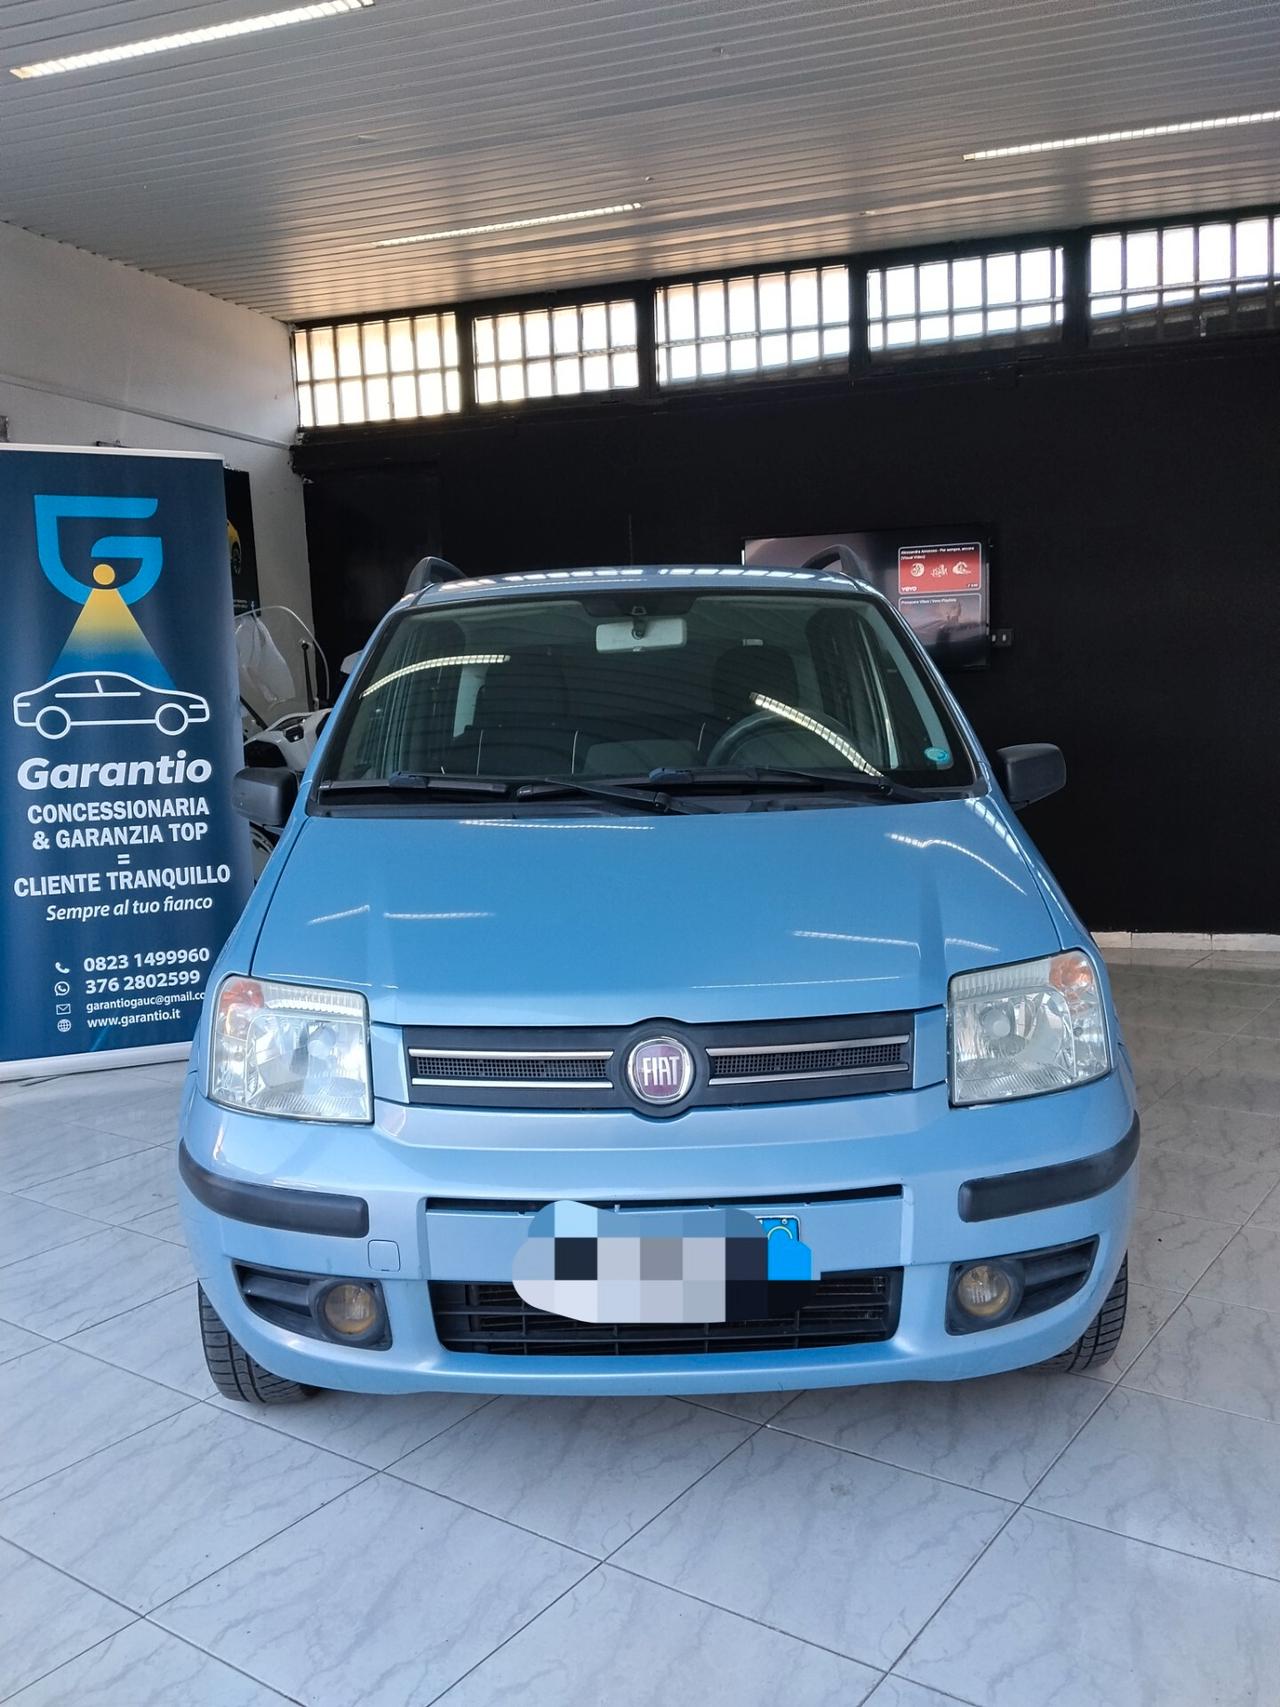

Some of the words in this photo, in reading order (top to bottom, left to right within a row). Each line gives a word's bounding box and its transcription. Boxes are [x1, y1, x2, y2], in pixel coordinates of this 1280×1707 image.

[17, 750, 212, 790] Garantio
[27, 797, 210, 824] CONCESSIONARIA
[32, 831, 50, 850] &
[56, 824, 163, 849] GARANZIA
[168, 822, 208, 841] TOP
[13, 873, 101, 897] CLIENTE
[106, 864, 231, 891] TRANQUILLO
[46, 904, 110, 922] Sempre
[113, 899, 129, 916] al
[133, 900, 160, 914] tuo
[163, 895, 213, 913] fianco
[83, 954, 129, 973] 0823
[134, 947, 210, 968] 1499960
[86, 977, 119, 995] 376
[124, 969, 200, 991] 2802599
[87, 1008, 181, 1028] www.garantio.it
[642, 1056, 680, 1086] FIAT
